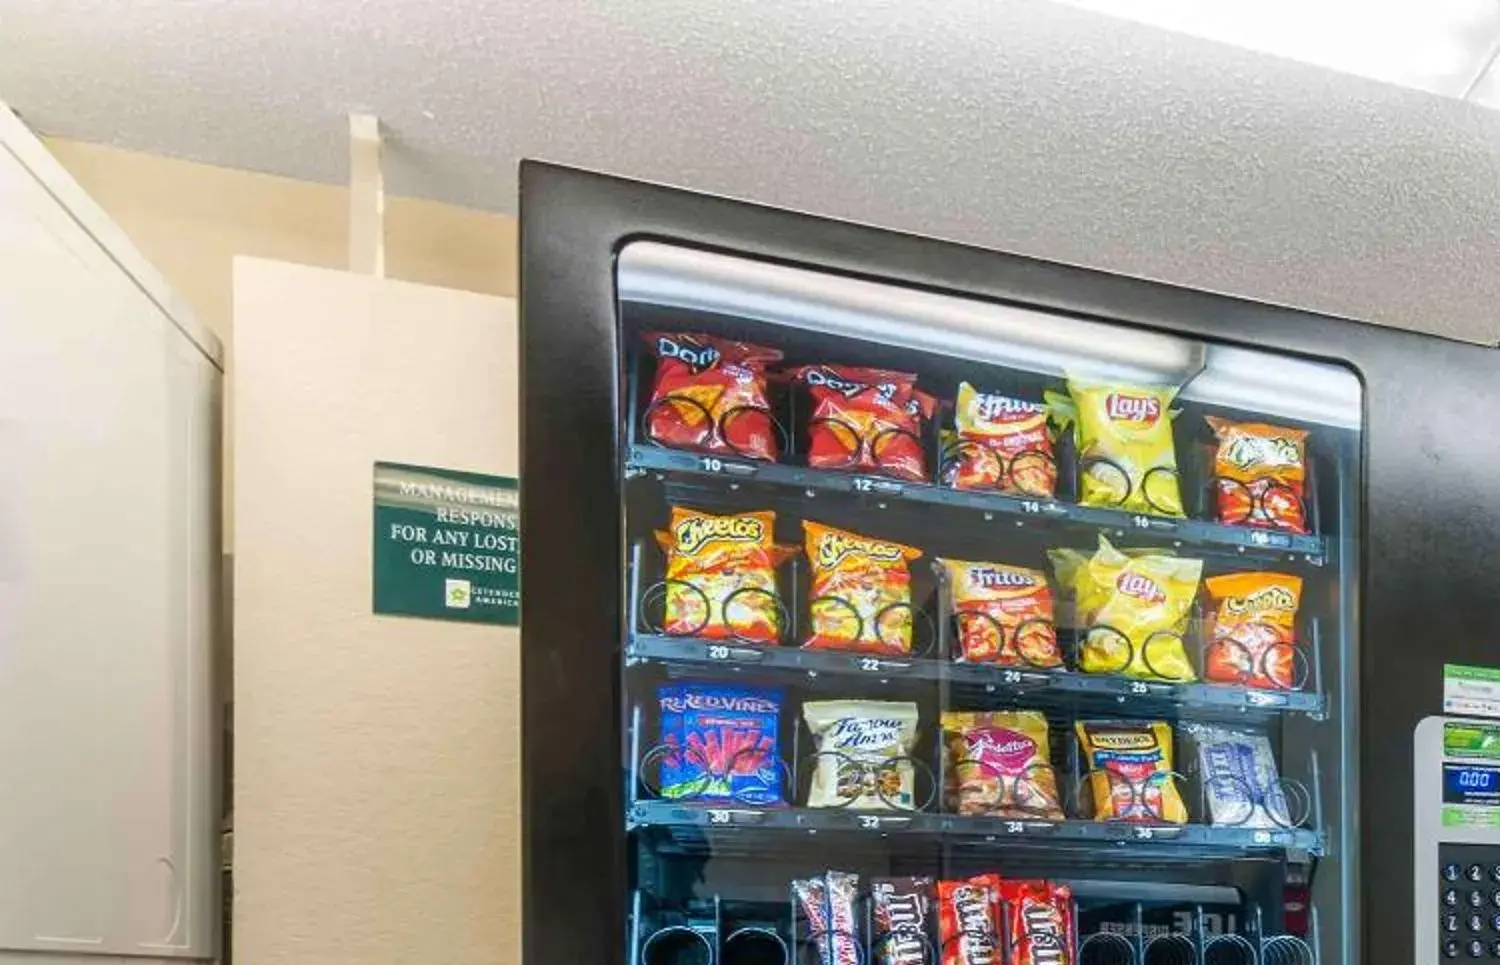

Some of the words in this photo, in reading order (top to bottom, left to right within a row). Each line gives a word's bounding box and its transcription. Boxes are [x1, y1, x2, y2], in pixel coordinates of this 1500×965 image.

[1109, 392, 1159, 418] Lay's
[703, 458, 721, 471] 10
[400, 481, 519, 507] MANAGEMEN
[855, 479, 872, 491] 12
[436, 507, 518, 530] RESPONS
[390, 523, 427, 543] FOR
[433, 528, 470, 547] ANY
[474, 533, 518, 552] LOST
[675, 517, 765, 556] Cheetos
[411, 549, 437, 566] OR
[441, 552, 517, 573] MISSING
[710, 645, 729, 659] 20
[862, 659, 879, 672] 22
[862, 816, 879, 829] 32
